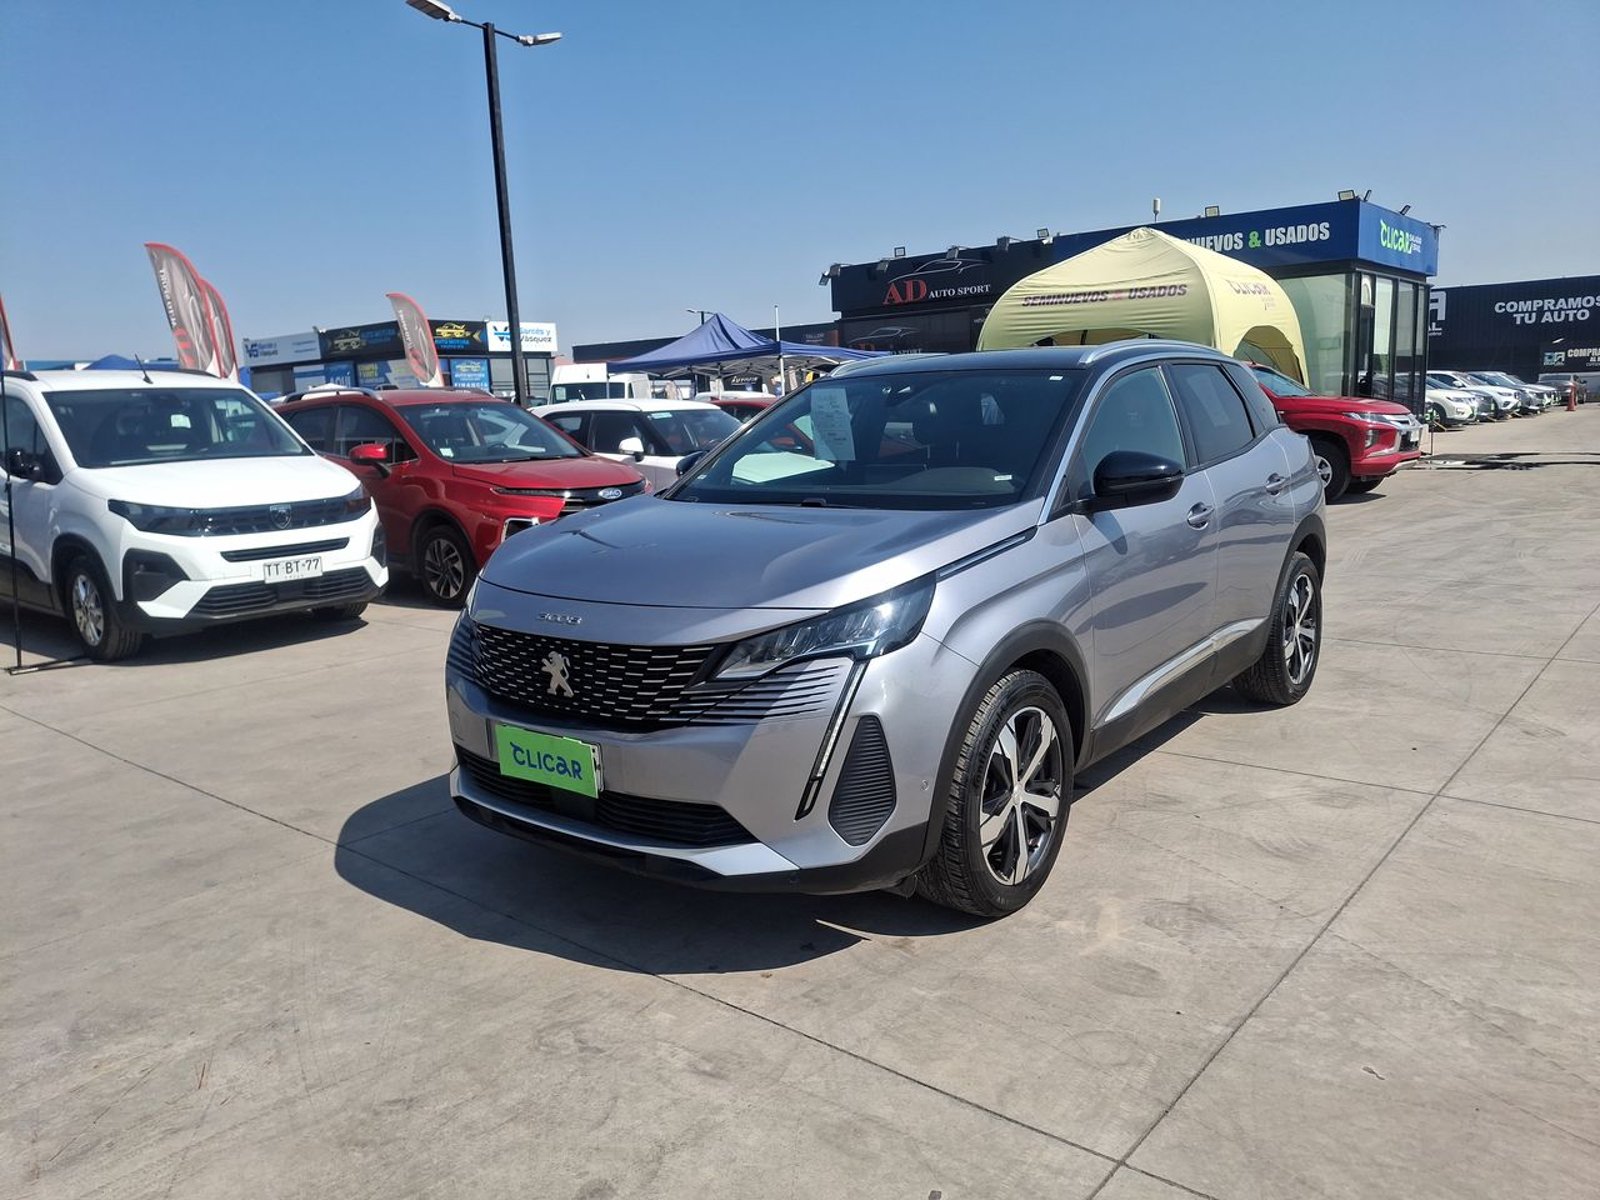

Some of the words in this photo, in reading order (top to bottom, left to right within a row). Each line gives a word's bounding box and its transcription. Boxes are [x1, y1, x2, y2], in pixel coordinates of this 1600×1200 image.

[1248, 230, 1262, 248] &
[1265, 222, 1330, 246] USADOS
[882, 279, 927, 305] AD
[928, 289, 956, 299] AUTO
[957, 284, 991, 296] SPORT
[1022, 290, 1110, 307] SEMINUEVOS
[1127, 284, 1188, 300] USADOS
[1513, 313, 1537, 325] TU
[1541, 309, 1590, 324] AUTO
